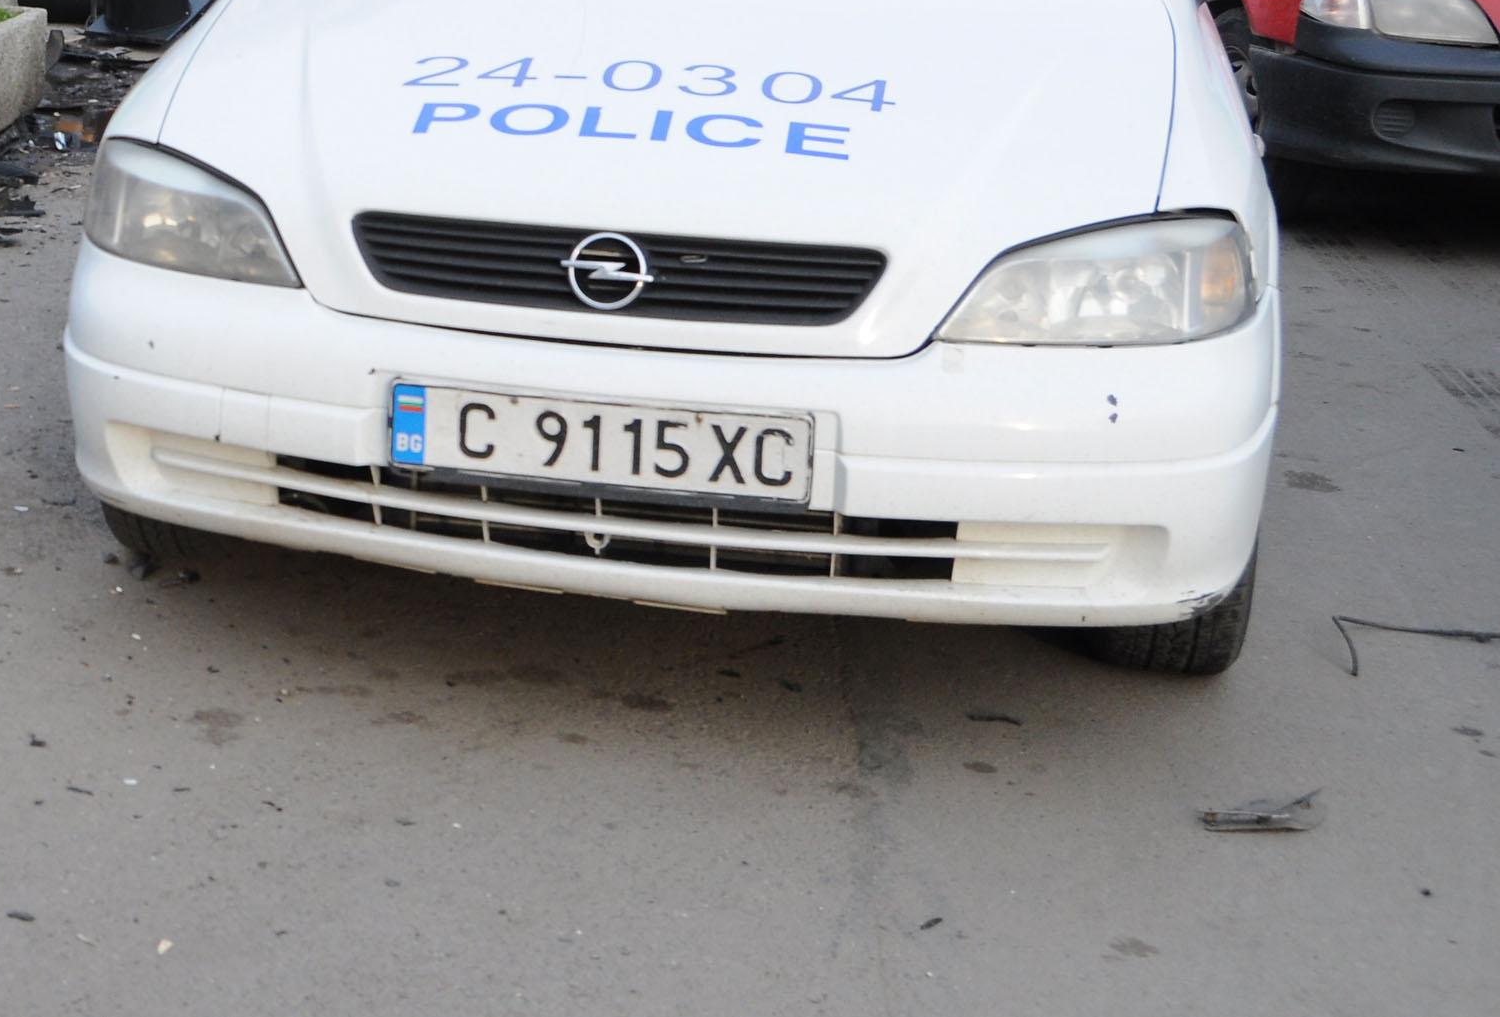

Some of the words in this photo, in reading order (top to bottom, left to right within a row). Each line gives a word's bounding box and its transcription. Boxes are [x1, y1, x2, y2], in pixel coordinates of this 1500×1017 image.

[402, 56, 897, 113] 24-0304
[412, 102, 851, 161] POLICE
[395, 433, 423, 454] BG
